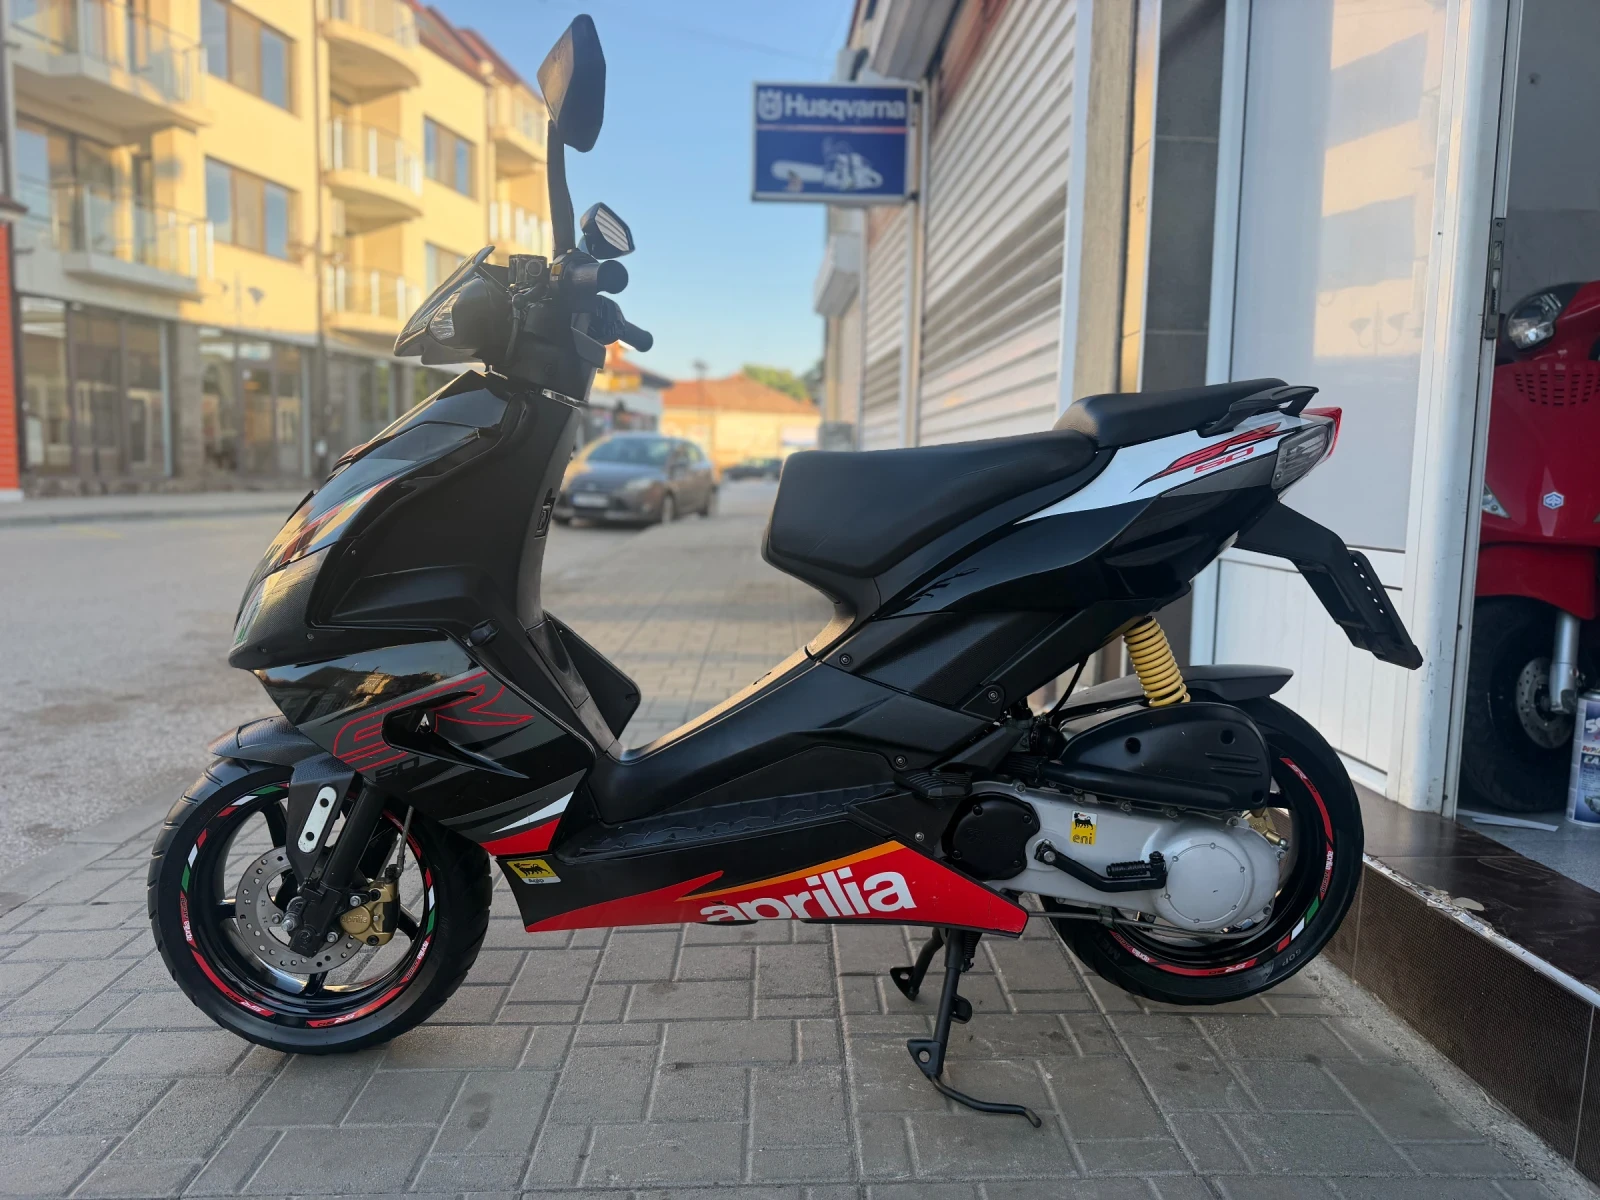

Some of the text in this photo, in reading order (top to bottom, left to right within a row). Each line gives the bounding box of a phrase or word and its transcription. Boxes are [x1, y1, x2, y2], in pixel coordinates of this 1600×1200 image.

[784, 92, 906, 122] Husqvarna
[1193, 446, 1254, 475] 50
[1072, 833, 1093, 845] eni
[699, 865, 917, 922] aprilia
